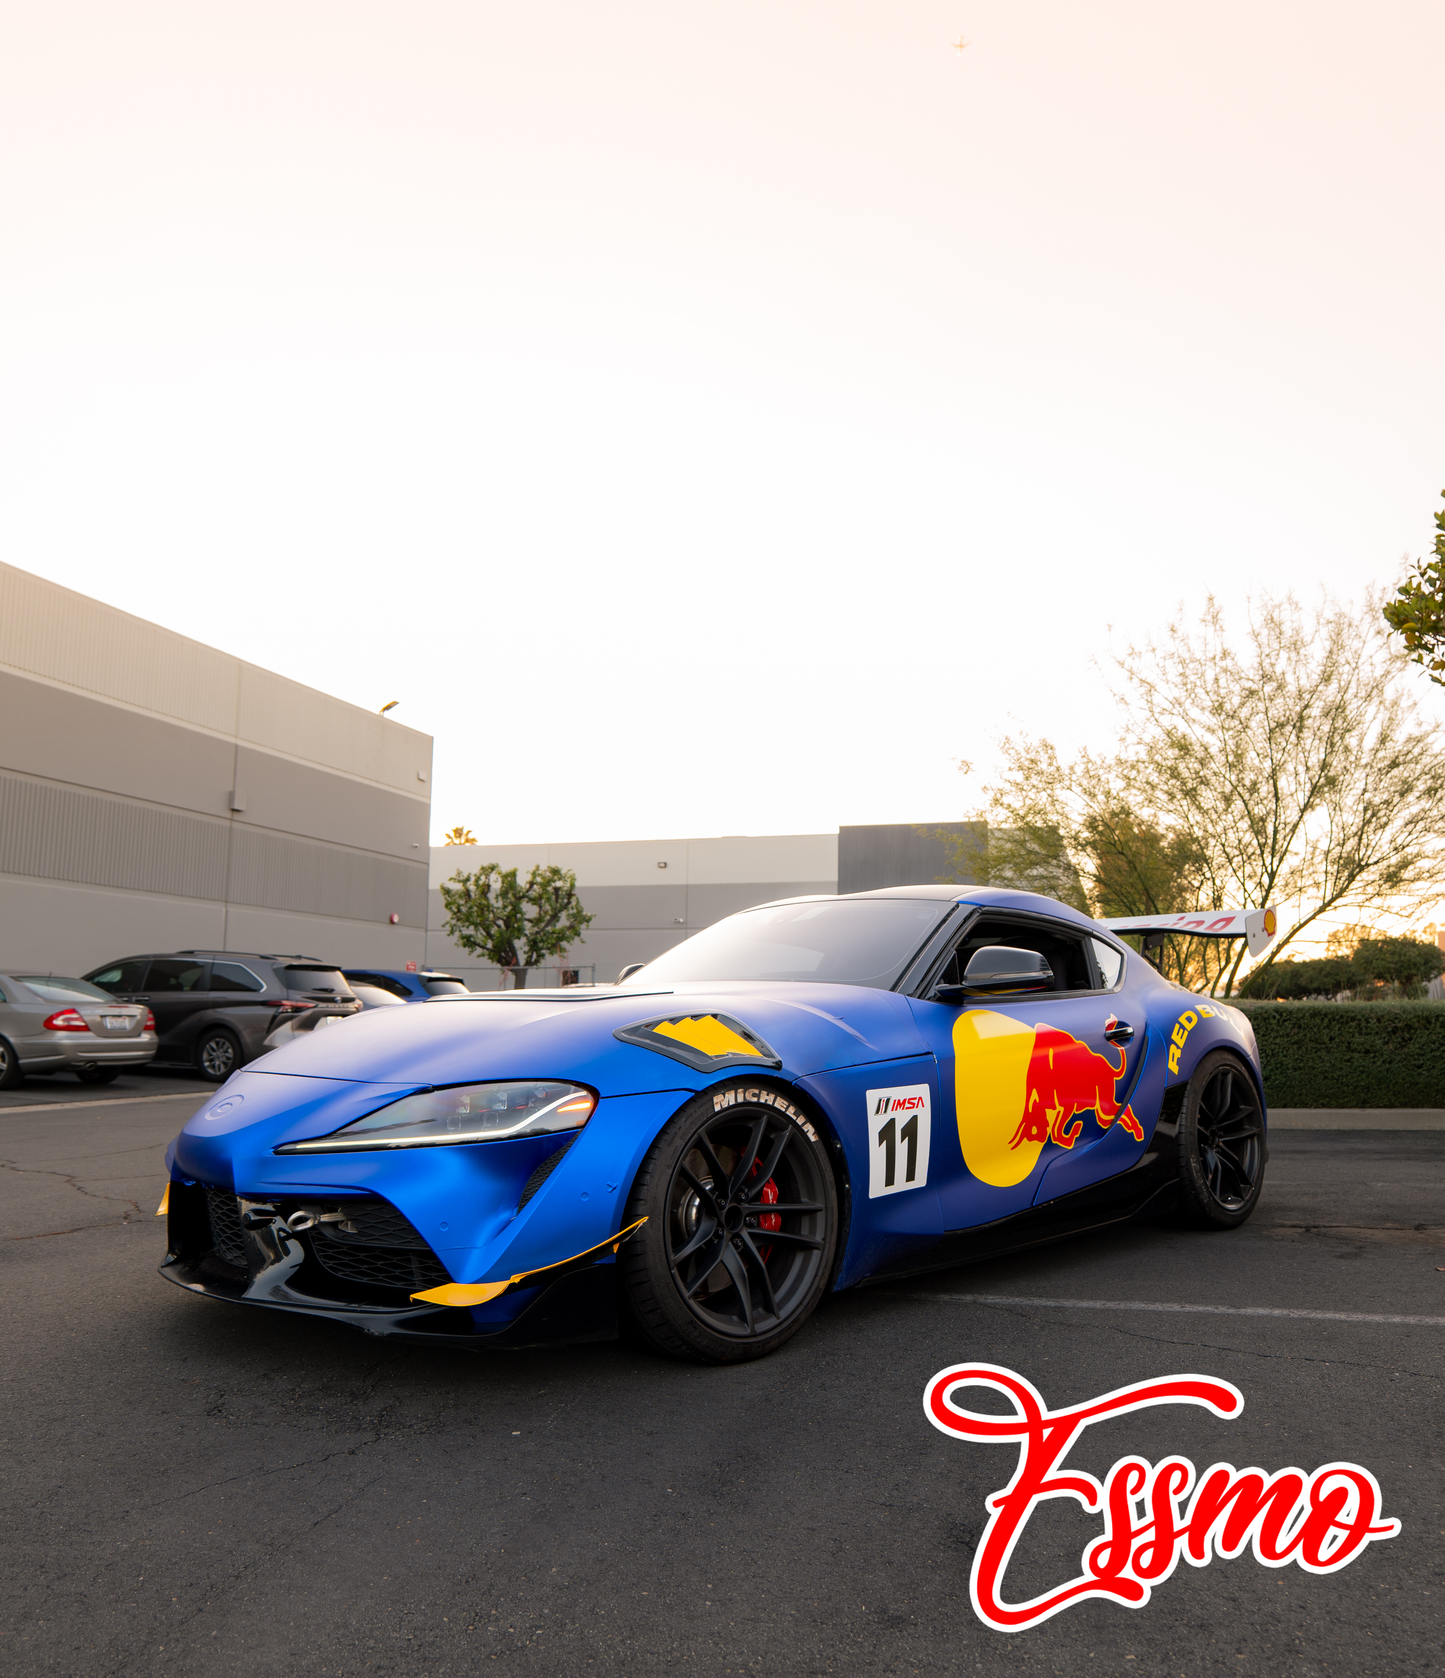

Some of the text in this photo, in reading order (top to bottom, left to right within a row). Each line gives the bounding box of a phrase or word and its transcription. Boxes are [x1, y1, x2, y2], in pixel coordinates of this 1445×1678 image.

[1168, 1010, 1199, 1075] RED
[712, 1088, 819, 1143] MICHELIN
[891, 1096, 925, 1112] IMSA
[878, 1114, 918, 1187] 11
